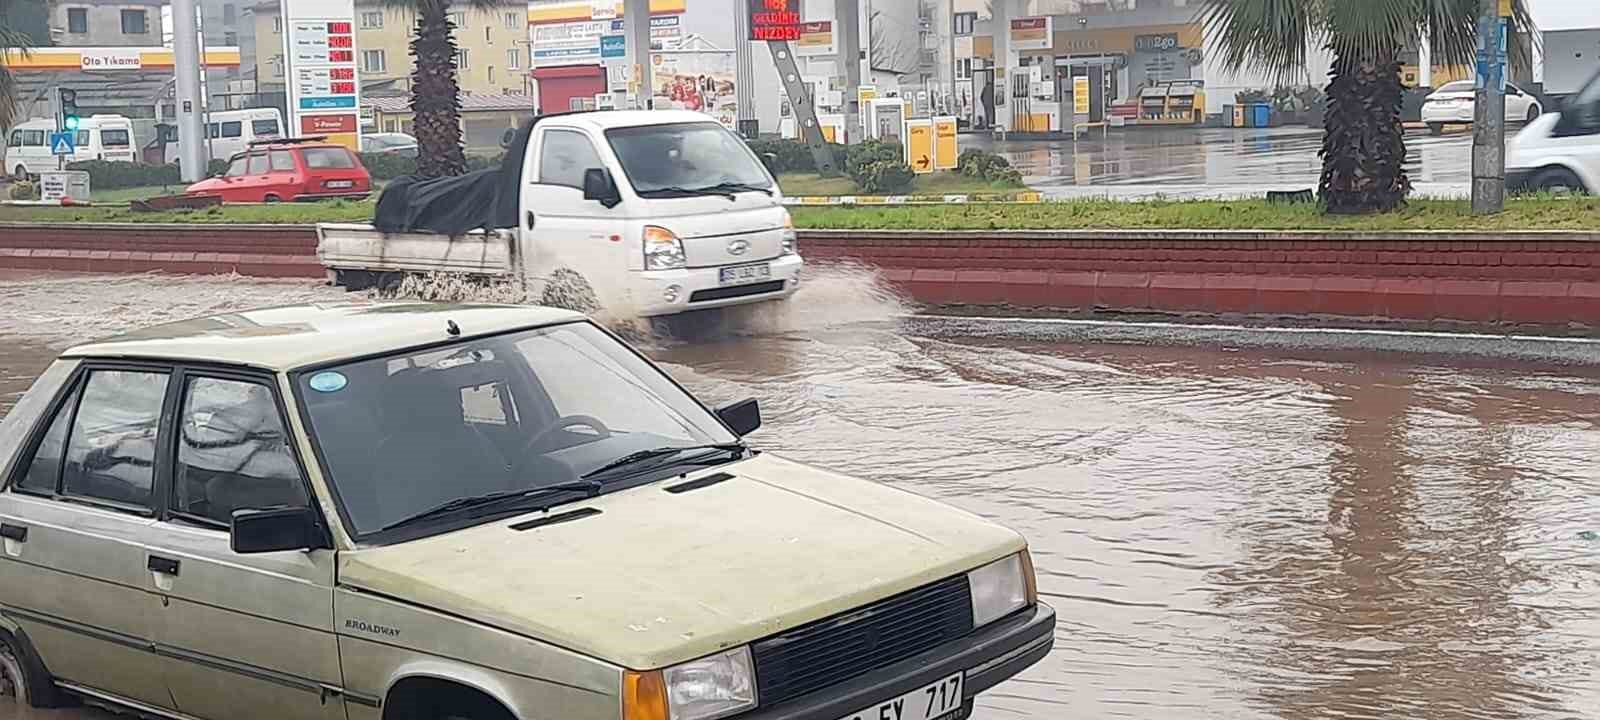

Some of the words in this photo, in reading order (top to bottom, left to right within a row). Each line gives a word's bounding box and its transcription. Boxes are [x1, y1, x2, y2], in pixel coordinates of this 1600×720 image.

[83, 56, 100, 65] Oto
[345, 619, 401, 636] BROADWAY
[926, 676, 960, 717] 717
